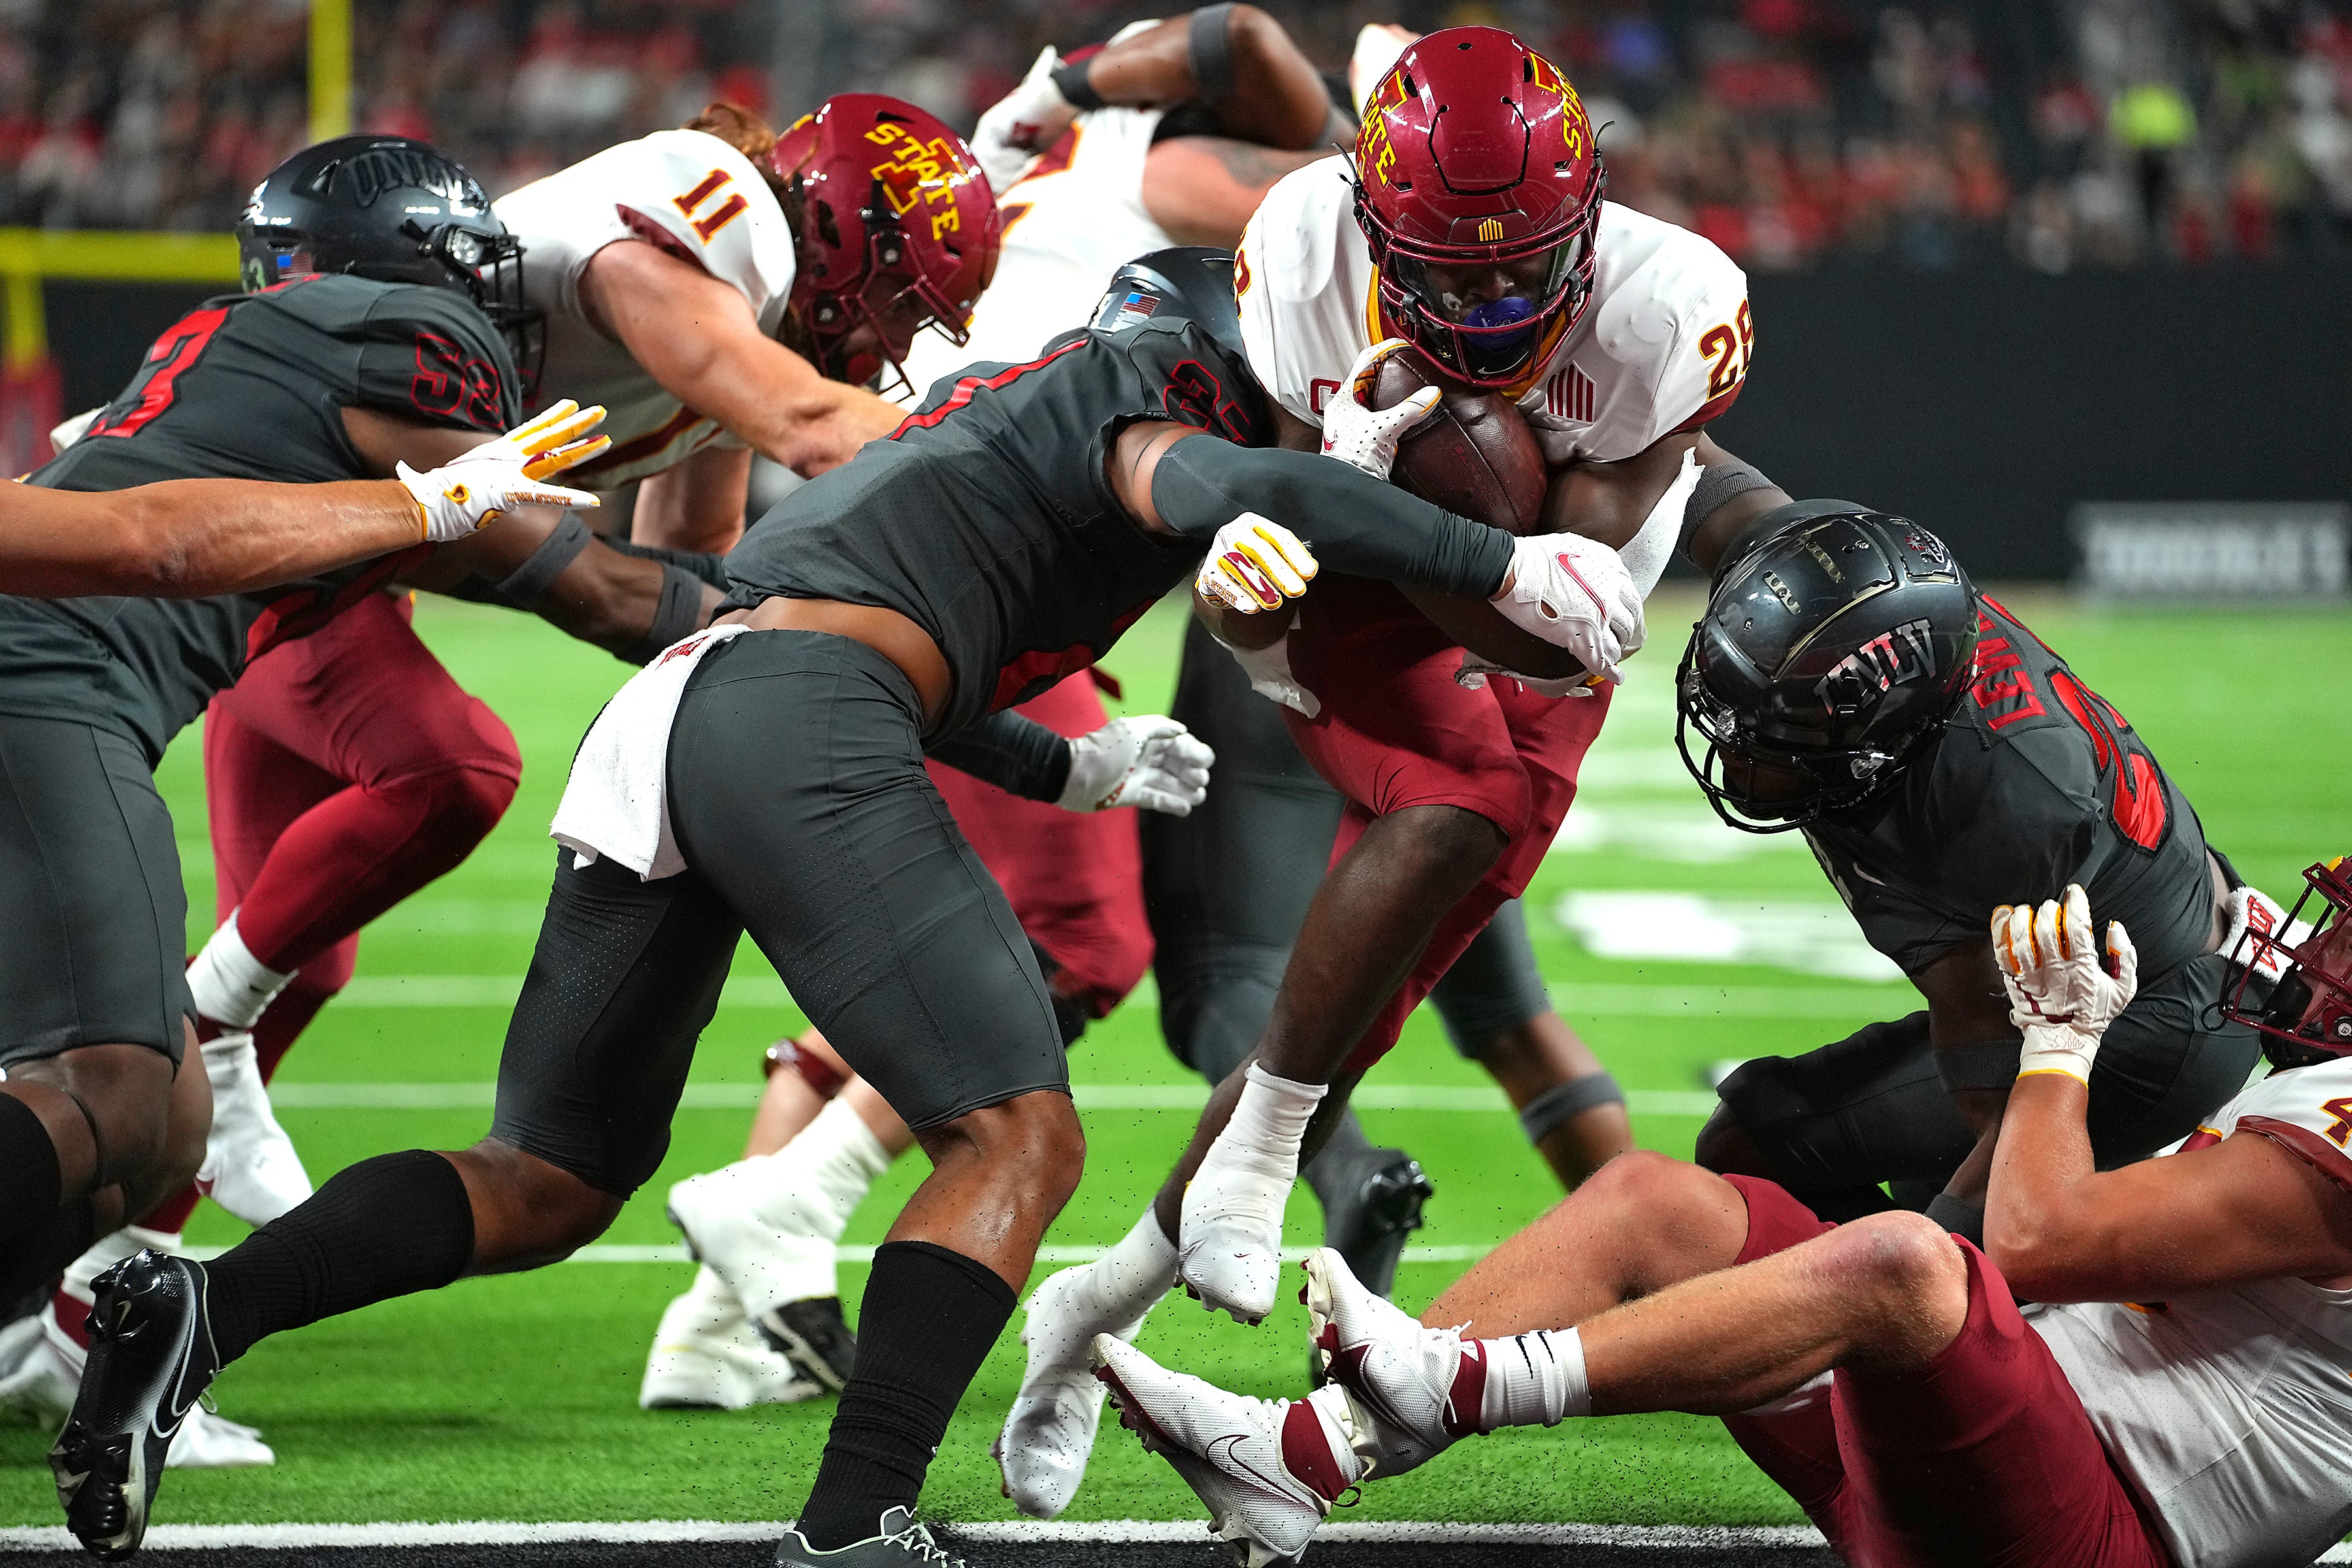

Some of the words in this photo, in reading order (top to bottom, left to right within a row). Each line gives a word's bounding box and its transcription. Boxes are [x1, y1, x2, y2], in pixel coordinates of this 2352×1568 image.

[864, 123, 961, 240] STATE
[1361, 90, 1397, 186] TATE
[672, 169, 749, 246] 11
[535, 493, 572, 506] STATE
[1210, 579, 1238, 606] STATE
[1813, 616, 1936, 715] UNLV
[1971, 610, 2048, 731] LEW
